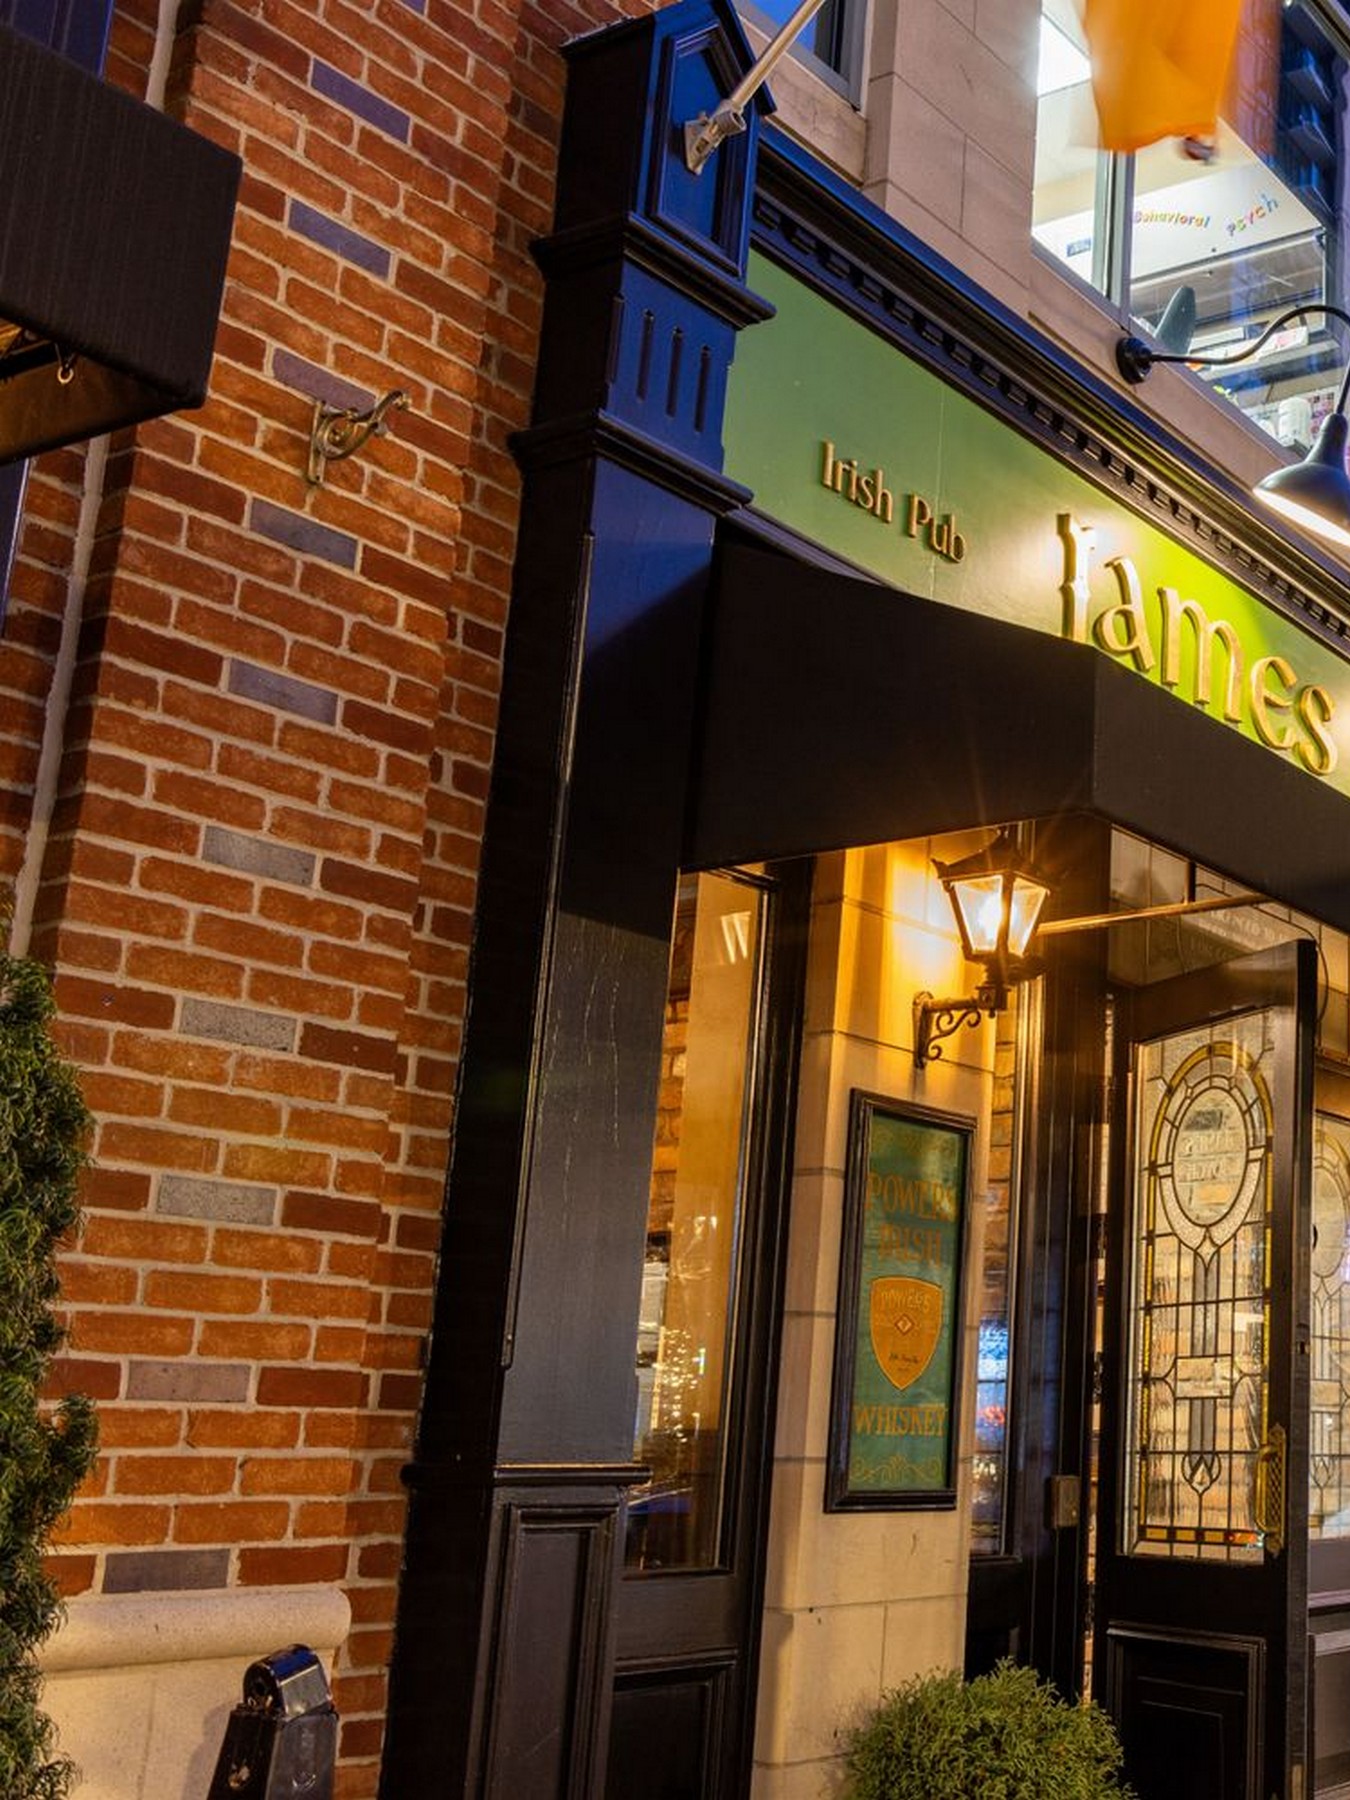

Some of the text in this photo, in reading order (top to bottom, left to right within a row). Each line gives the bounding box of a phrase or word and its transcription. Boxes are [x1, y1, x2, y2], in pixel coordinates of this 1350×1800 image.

[821, 440, 967, 564] Irish Pub
[1057, 513, 1338, 776] James
[853, 1402, 947, 1438] WHISKEY
